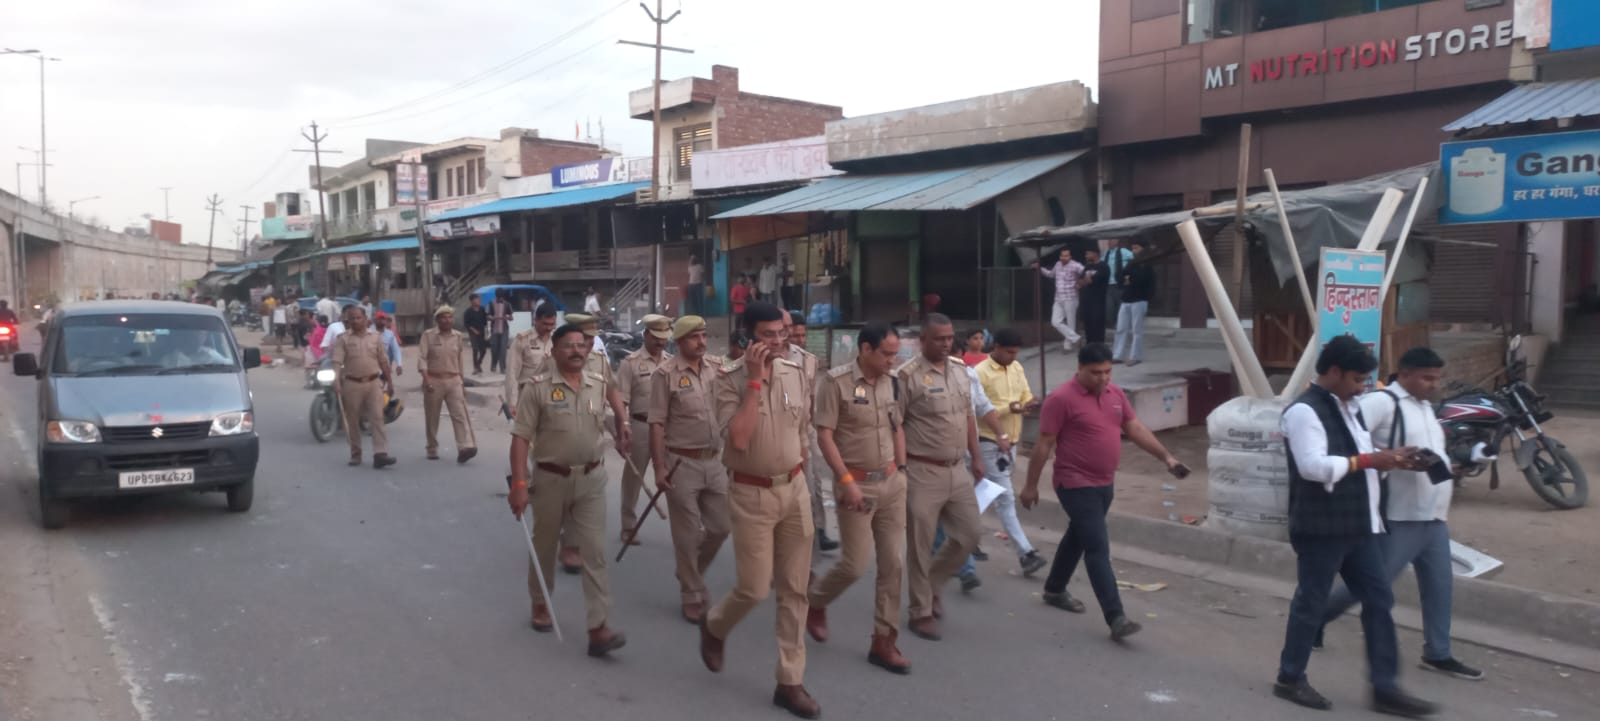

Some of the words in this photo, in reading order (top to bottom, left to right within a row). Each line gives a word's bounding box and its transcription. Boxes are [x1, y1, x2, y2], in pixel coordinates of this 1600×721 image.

[1204, 62, 1239, 90] MT
[1250, 38, 1398, 82] NUTRITION
[1404, 19, 1513, 61] STORE
[560, 163, 600, 184] LUMINOUS
[1516, 151, 1600, 177] Gan
[1513, 189, 1526, 201] हर
[1531, 188, 1545, 200] हर
[1323, 271, 1381, 324] हिन्दुस्तान
[1228, 428, 1263, 441] Ganga
